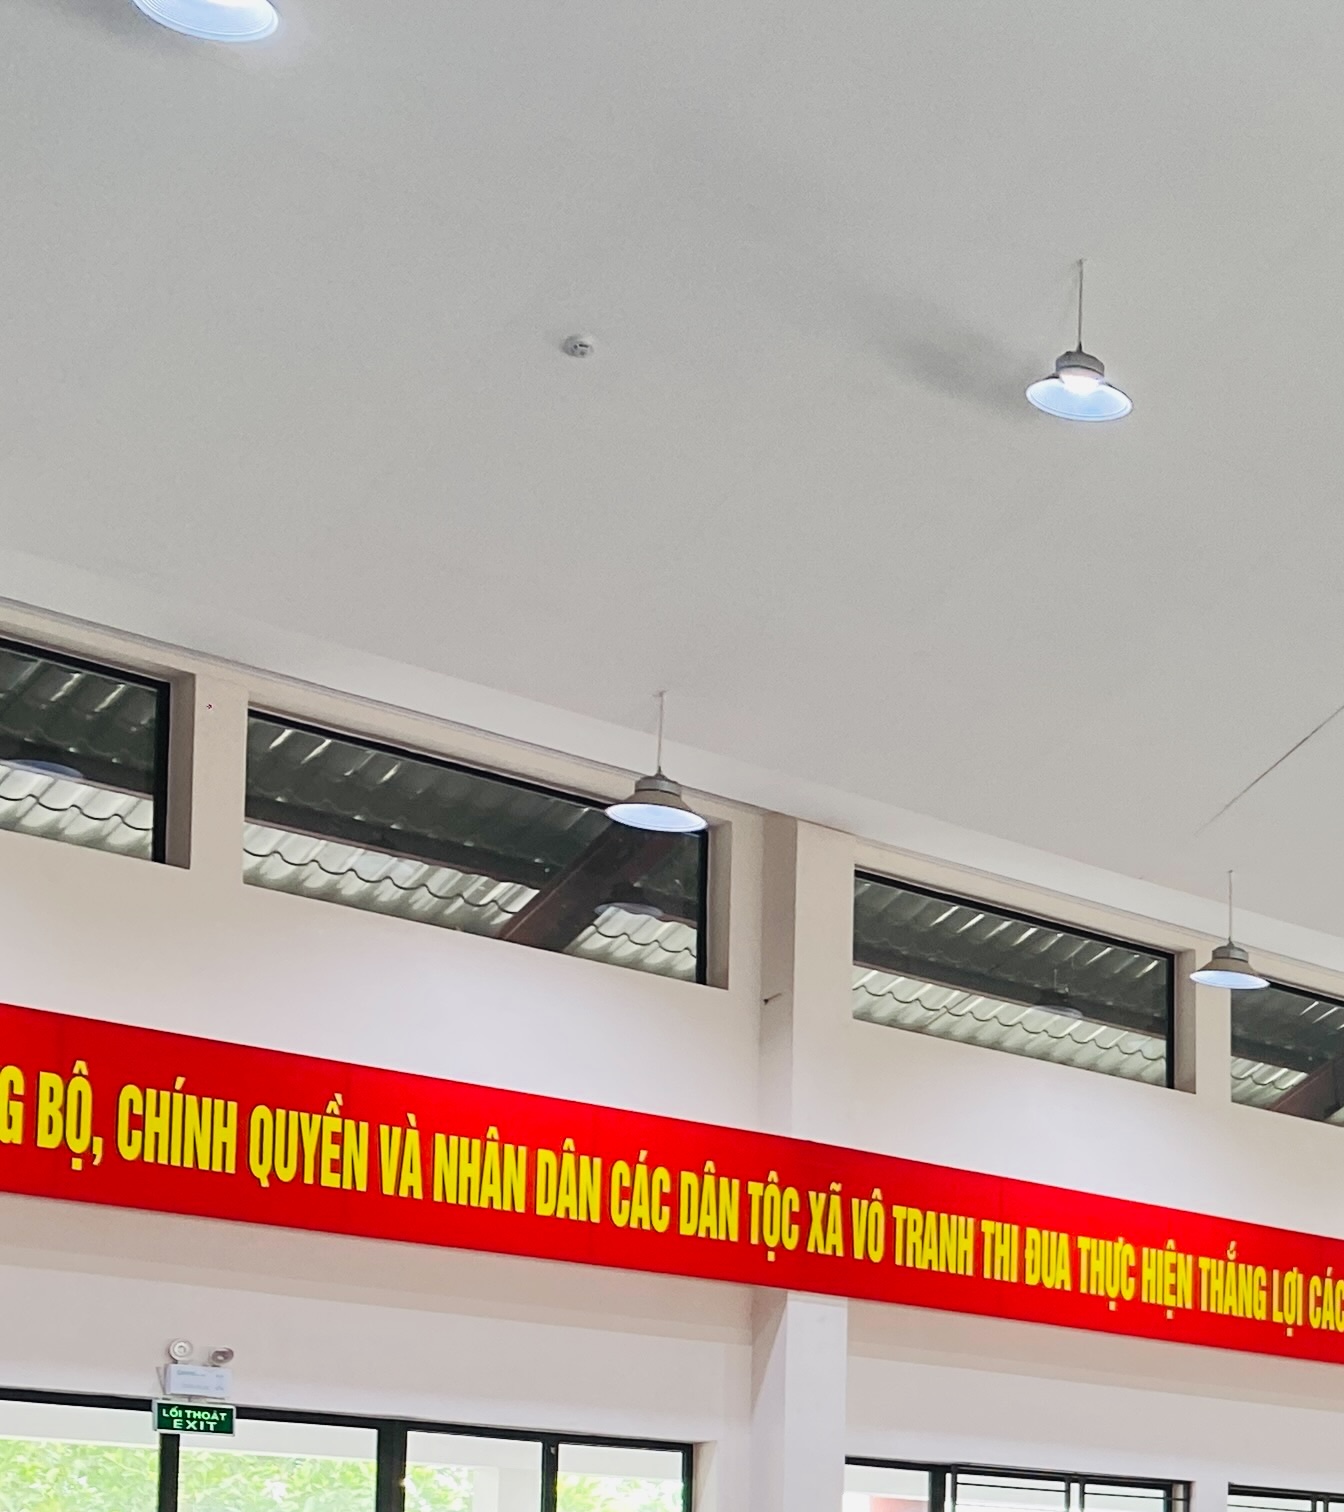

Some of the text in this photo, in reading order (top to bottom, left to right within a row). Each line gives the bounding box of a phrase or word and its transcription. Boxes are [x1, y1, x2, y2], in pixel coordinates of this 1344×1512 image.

[37, 1060, 104, 1171] BỘ,
[117, 1076, 238, 1174] CHÍNH
[249, 1093, 369, 1192] QUYỀN
[379, 1112, 424, 1200] VÀ
[433, 1126, 528, 1213] NHÂN
[535, 1137, 602, 1224] DÂN
[610, 1149, 672, 1233] CÁC
[679, 1160, 740, 1242] DÂN
[747, 1170, 801, 1262] TỘC
[806, 1181, 844, 1257] XÃ
[851, 1187, 886, 1263] VÔ
[892, 1204, 975, 1277] TRANH
[980, 1219, 1020, 1283] THI
[1024, 1226, 1072, 1292] ĐUA
[1076, 1234, 1137, 1311] THỰC
[1141, 1238, 1194, 1320] HIỆN
[1197, 1240, 1268, 1322] THẮNG
[1272, 1266, 1304, 1337] LỢI
[162, 1406, 183, 1418] LỐI
[173, 1419, 217, 1431] EXIT
